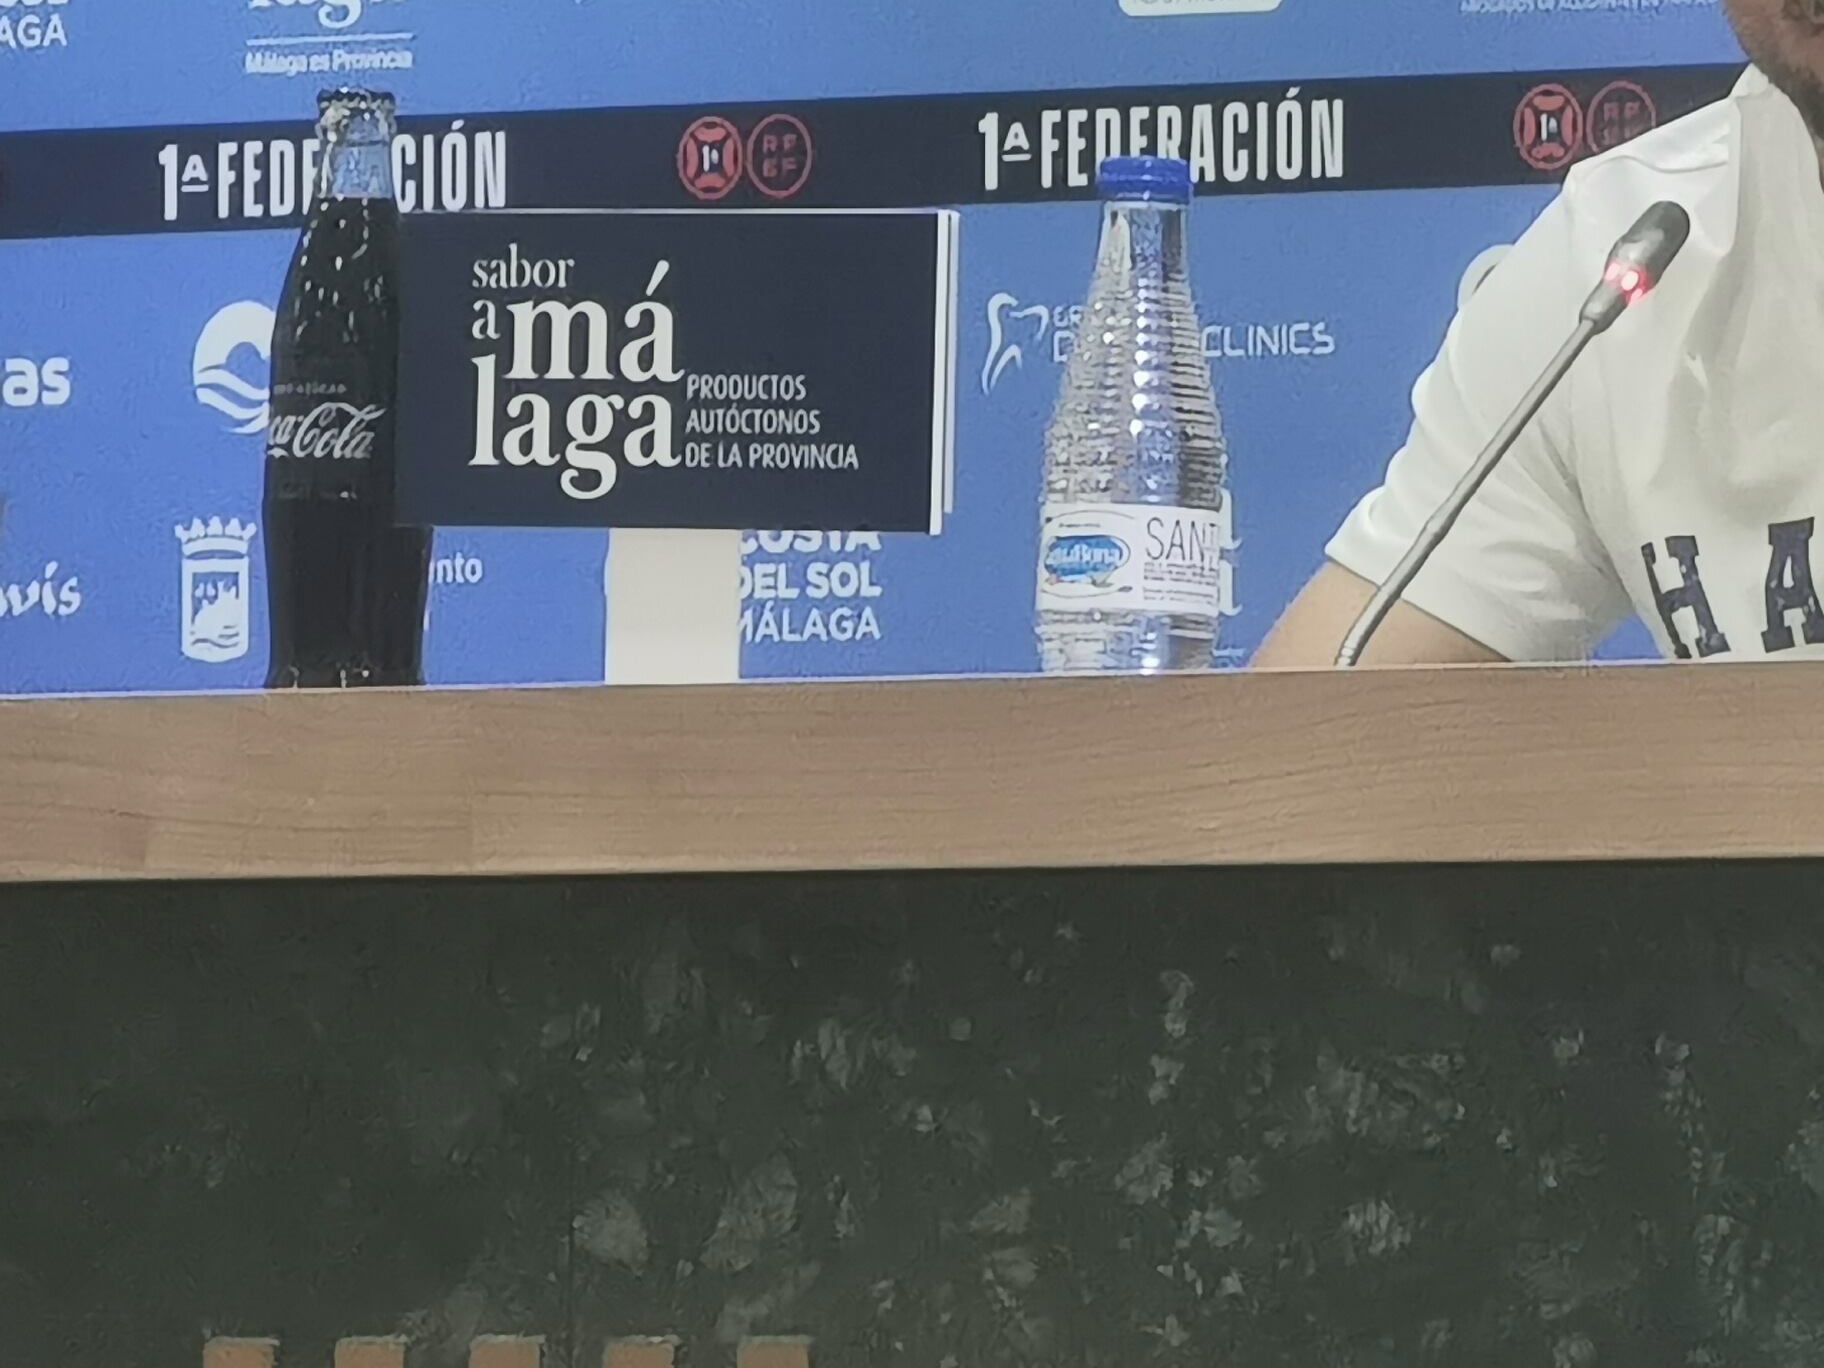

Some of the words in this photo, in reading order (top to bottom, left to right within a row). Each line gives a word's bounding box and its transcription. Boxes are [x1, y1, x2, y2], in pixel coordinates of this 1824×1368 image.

[472, 242, 575, 289] sabor
[502, 257, 686, 385] má
[1199, 321, 1335, 361] CLINICS
[686, 373, 807, 401] PRODUCTOS
[467, 352, 684, 501] laga
[685, 402, 821, 435] AUTÓCTONOS
[685, 441, 712, 468] DE
[717, 441, 743, 468] LA
[748, 442, 859, 470] PROVINCIA
[805, 560, 883, 599] SOL
